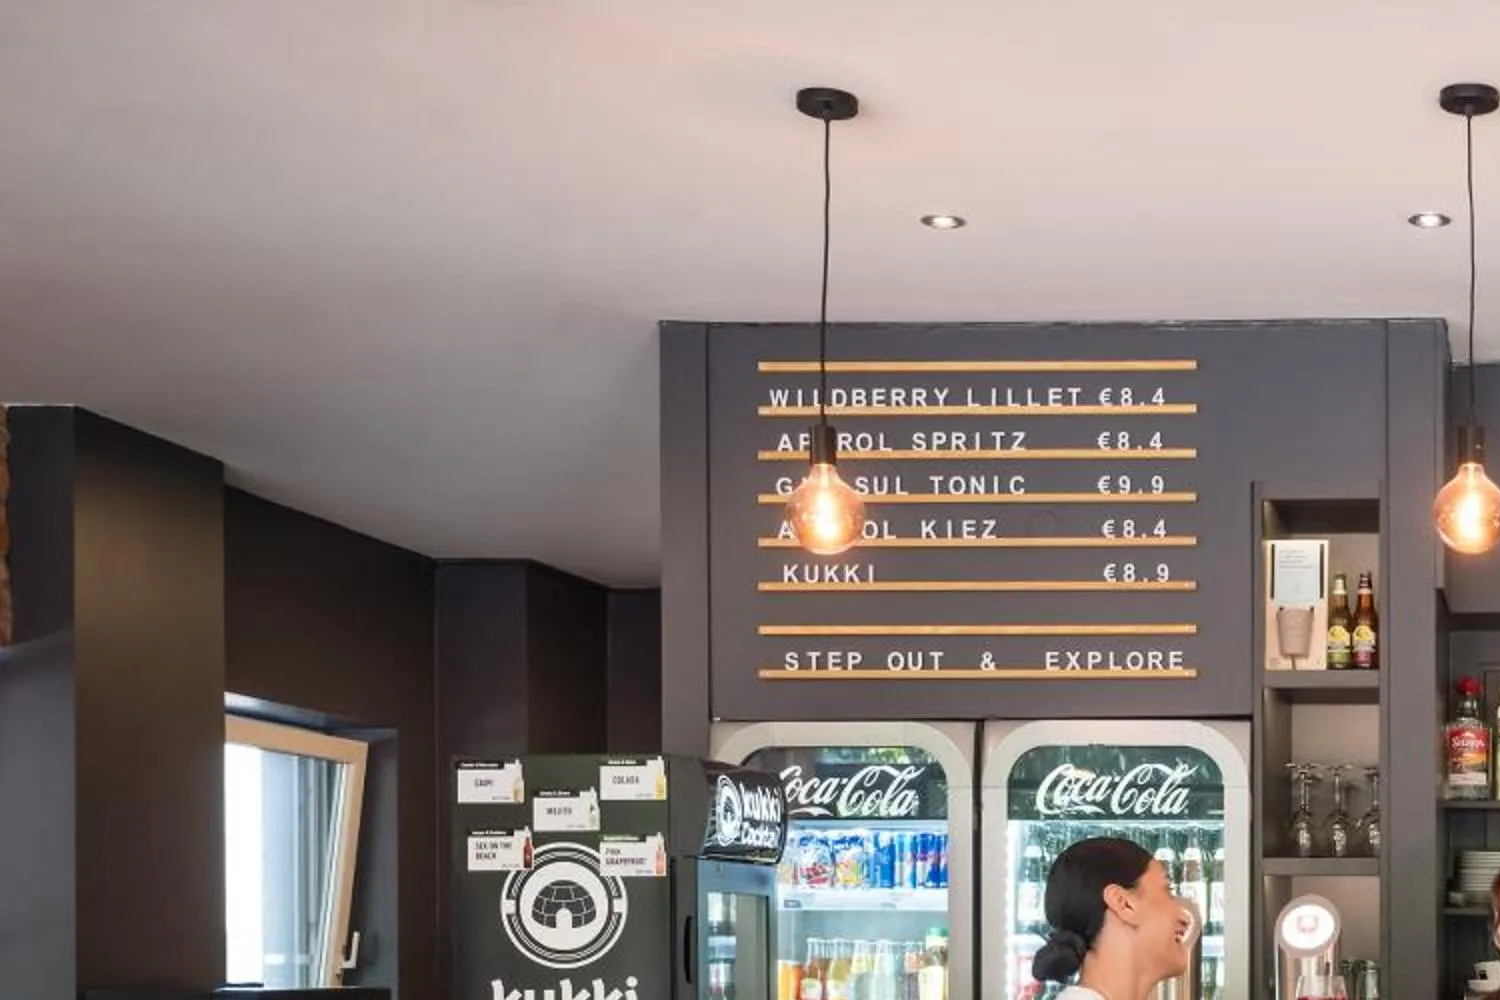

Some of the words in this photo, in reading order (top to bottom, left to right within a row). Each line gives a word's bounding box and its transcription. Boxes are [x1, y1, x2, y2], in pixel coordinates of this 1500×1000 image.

[769, 388, 949, 407] WILDBERRY
[967, 387, 1083, 407] LILLET
[1099, 387, 1165, 407] €8.4
[777, 432, 893, 452] APROL
[911, 431, 1027, 451] SPRITZ
[1097, 431, 1163, 451] €8.4
[929, 475, 1026, 495] TONIC
[1097, 475, 1164, 494] €9.9
[921, 520, 998, 539] KIEZ
[1101, 519, 1168, 538] €8.4
[782, 564, 876, 584] KUKKI
[1103, 563, 1170, 583] €8.9
[783, 652, 863, 672] STEP
[886, 652, 944, 672] OUT
[979, 652, 998, 672] &
[1044, 651, 1185, 671] EXPLORE
[1036, 763, 1200, 815] Coca-Cola
